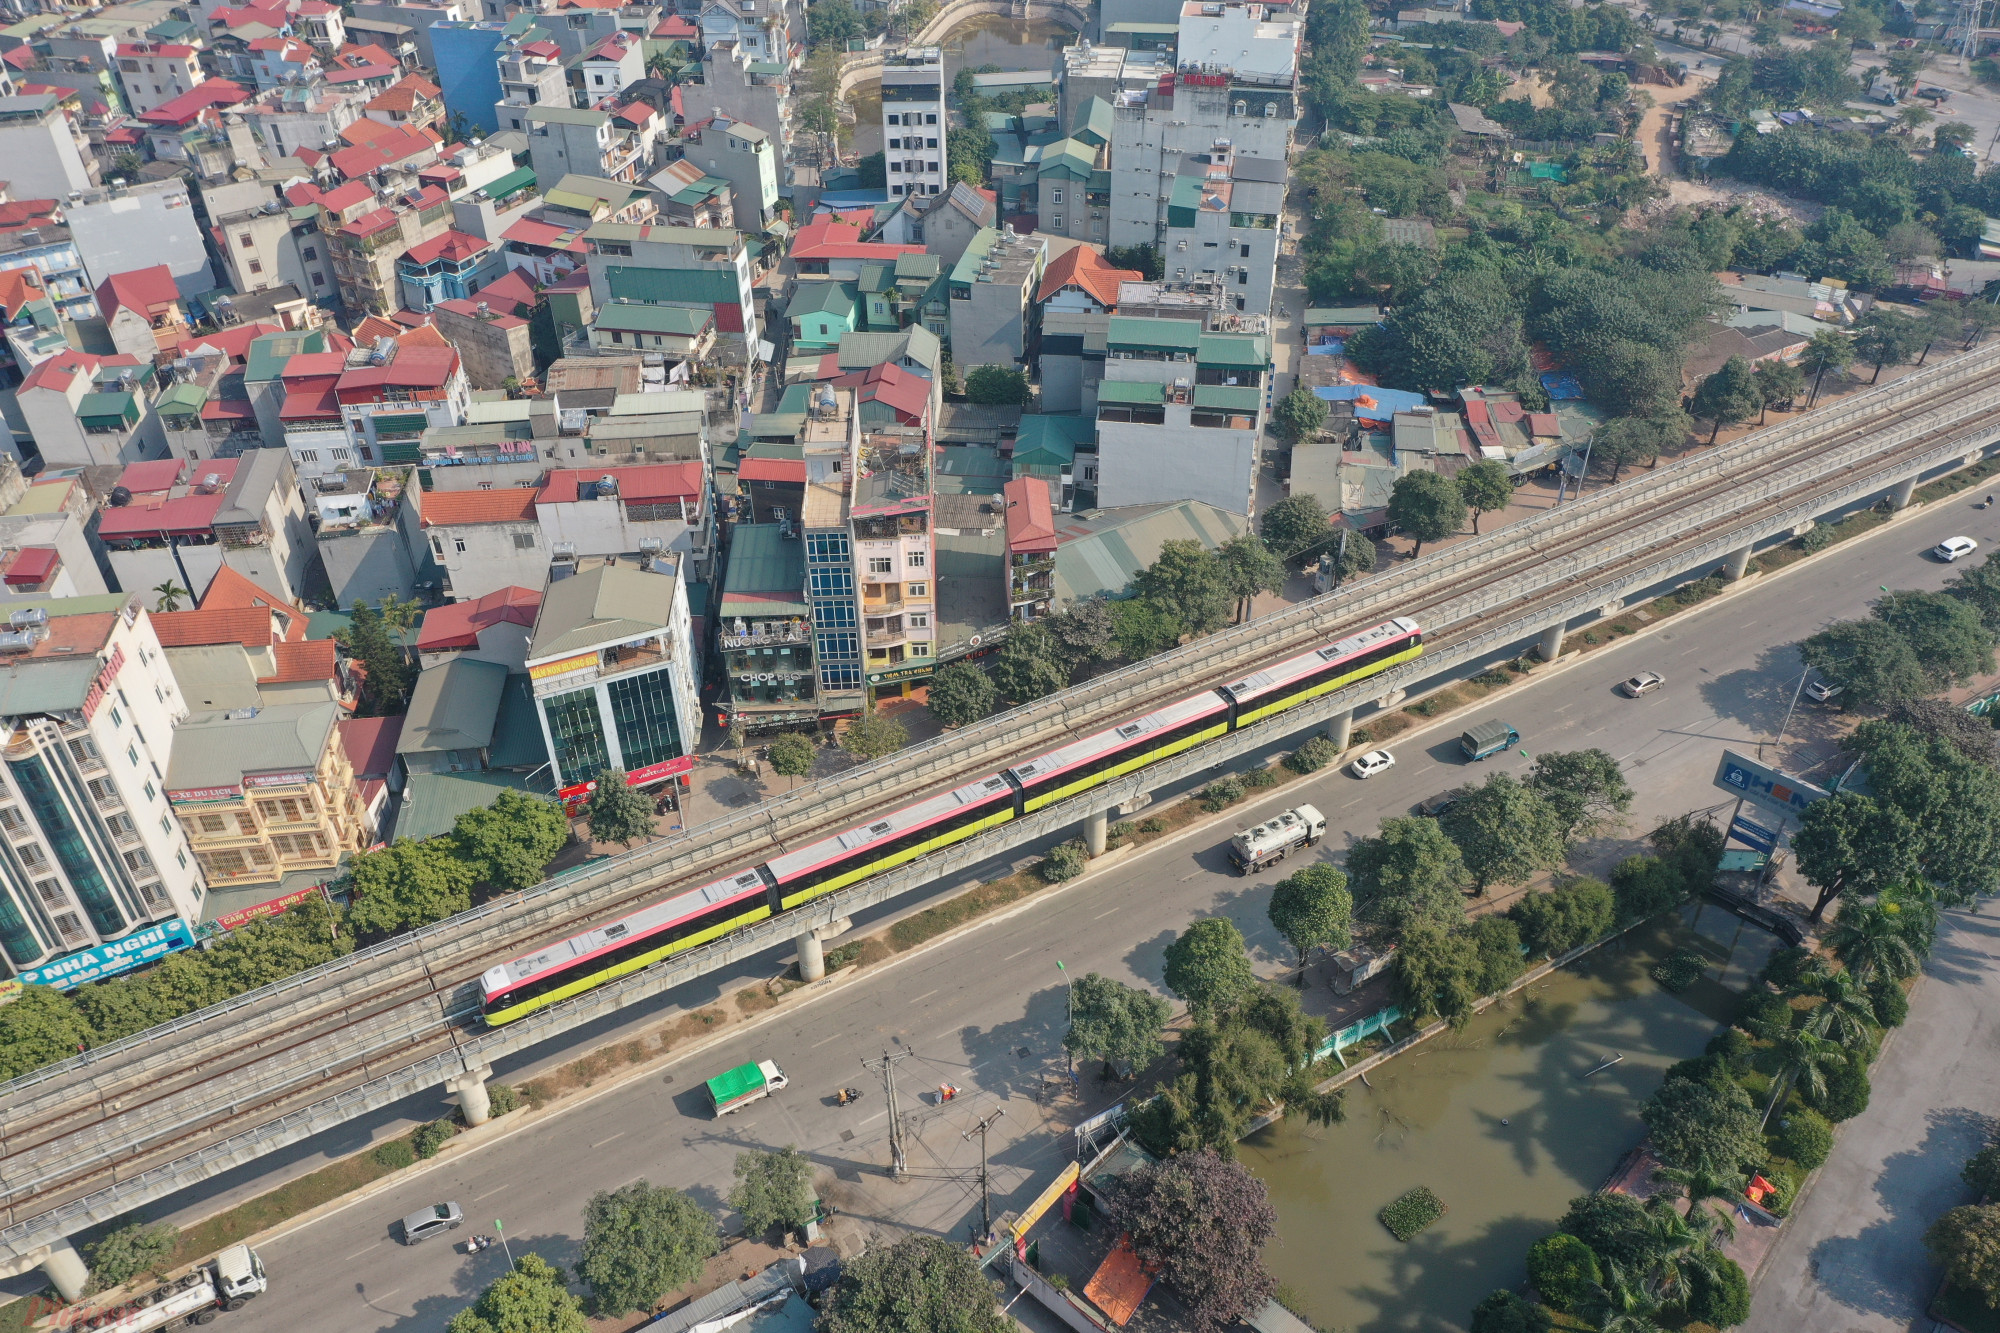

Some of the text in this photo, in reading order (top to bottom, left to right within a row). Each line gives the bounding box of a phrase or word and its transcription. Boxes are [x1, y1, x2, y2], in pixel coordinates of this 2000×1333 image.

[740, 672, 775, 682] CHOP
[223, 914, 245, 925] CAM
[246, 904, 271, 918] CANH
[42, 952, 99, 980] NHÀ
[103, 924, 166, 959] NGHỈ
